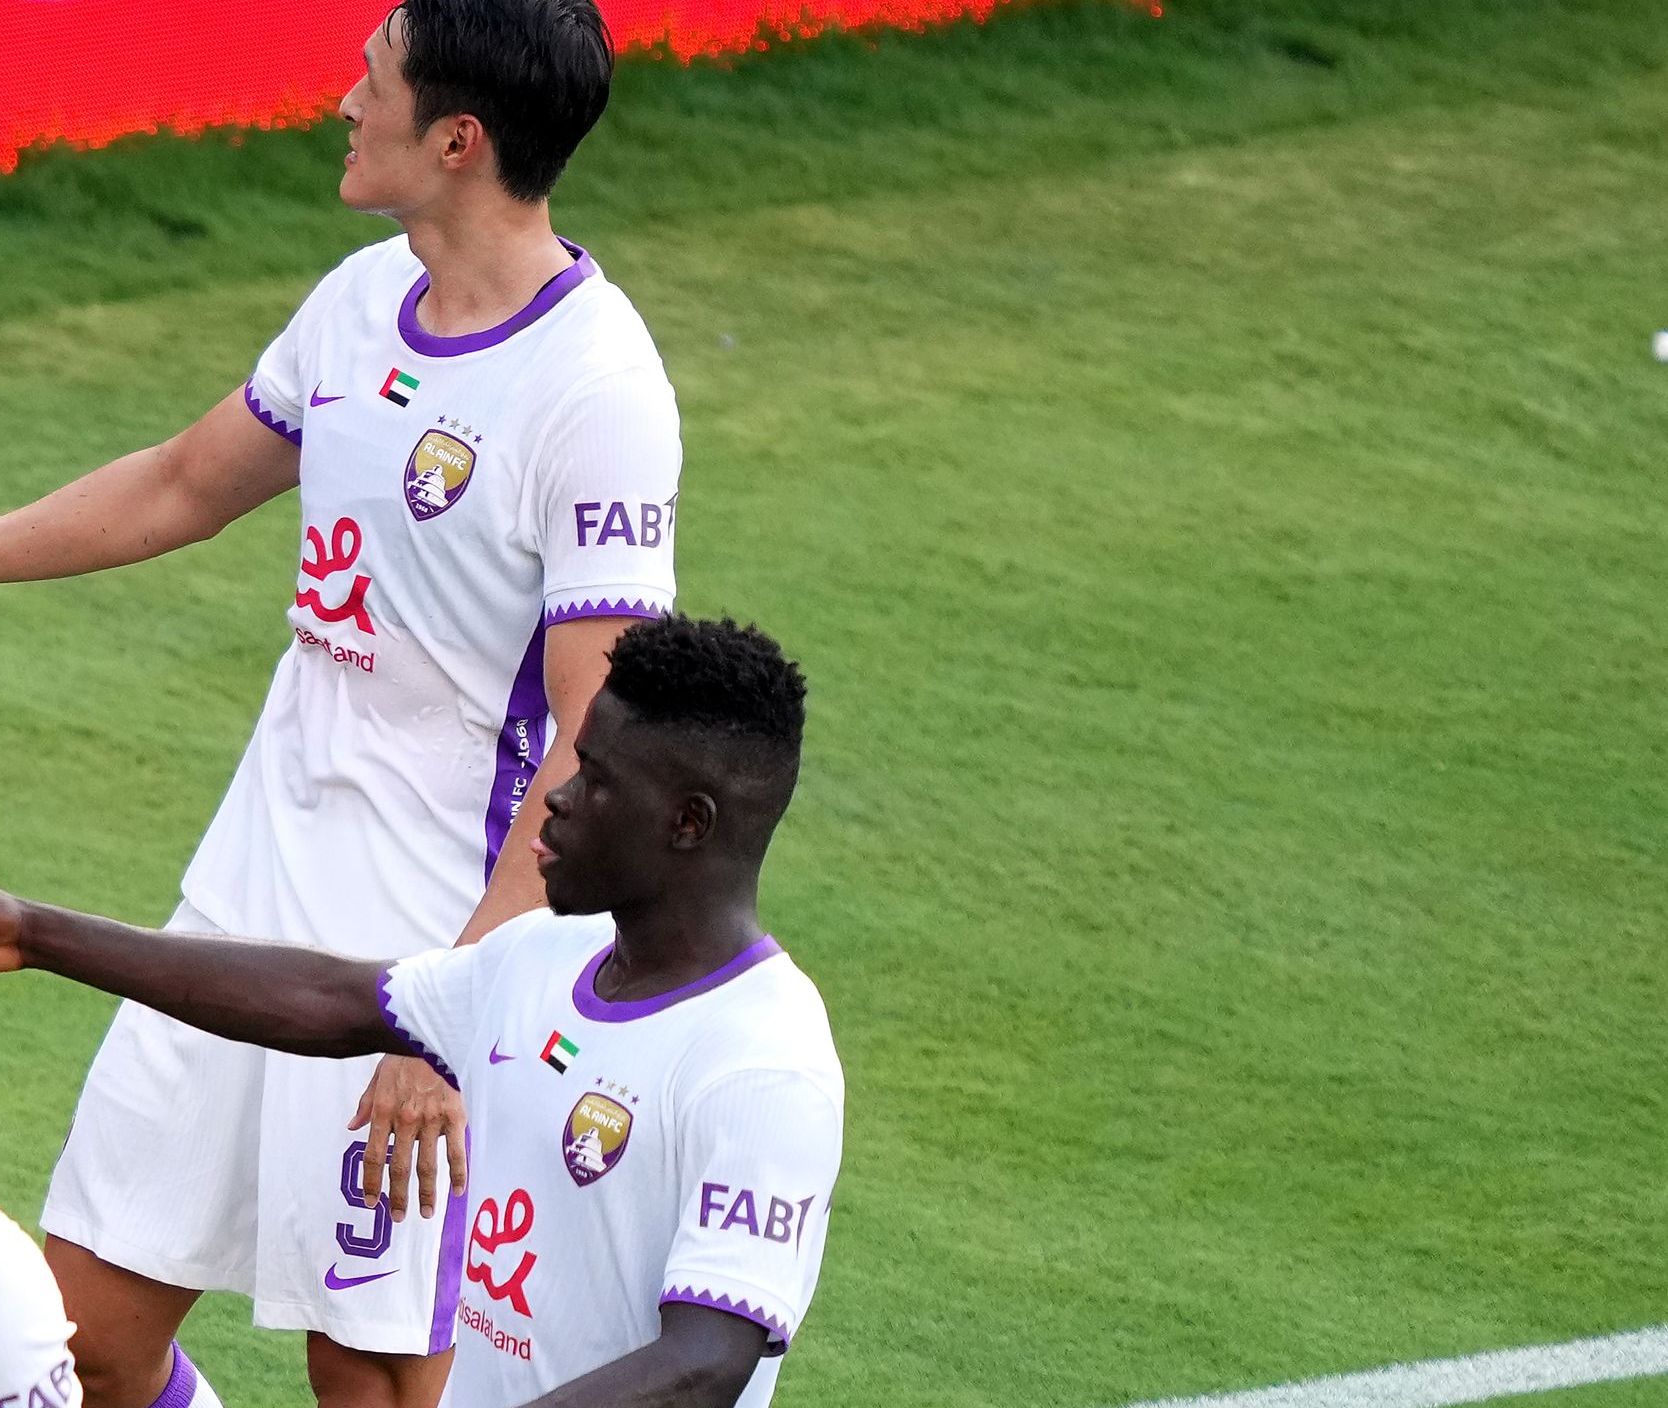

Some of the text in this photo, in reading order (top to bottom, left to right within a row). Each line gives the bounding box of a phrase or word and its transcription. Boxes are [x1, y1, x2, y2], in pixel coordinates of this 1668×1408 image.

[333, 645, 375, 673] and
[512, 777, 527, 797] FC
[493, 1331, 532, 1361] and
